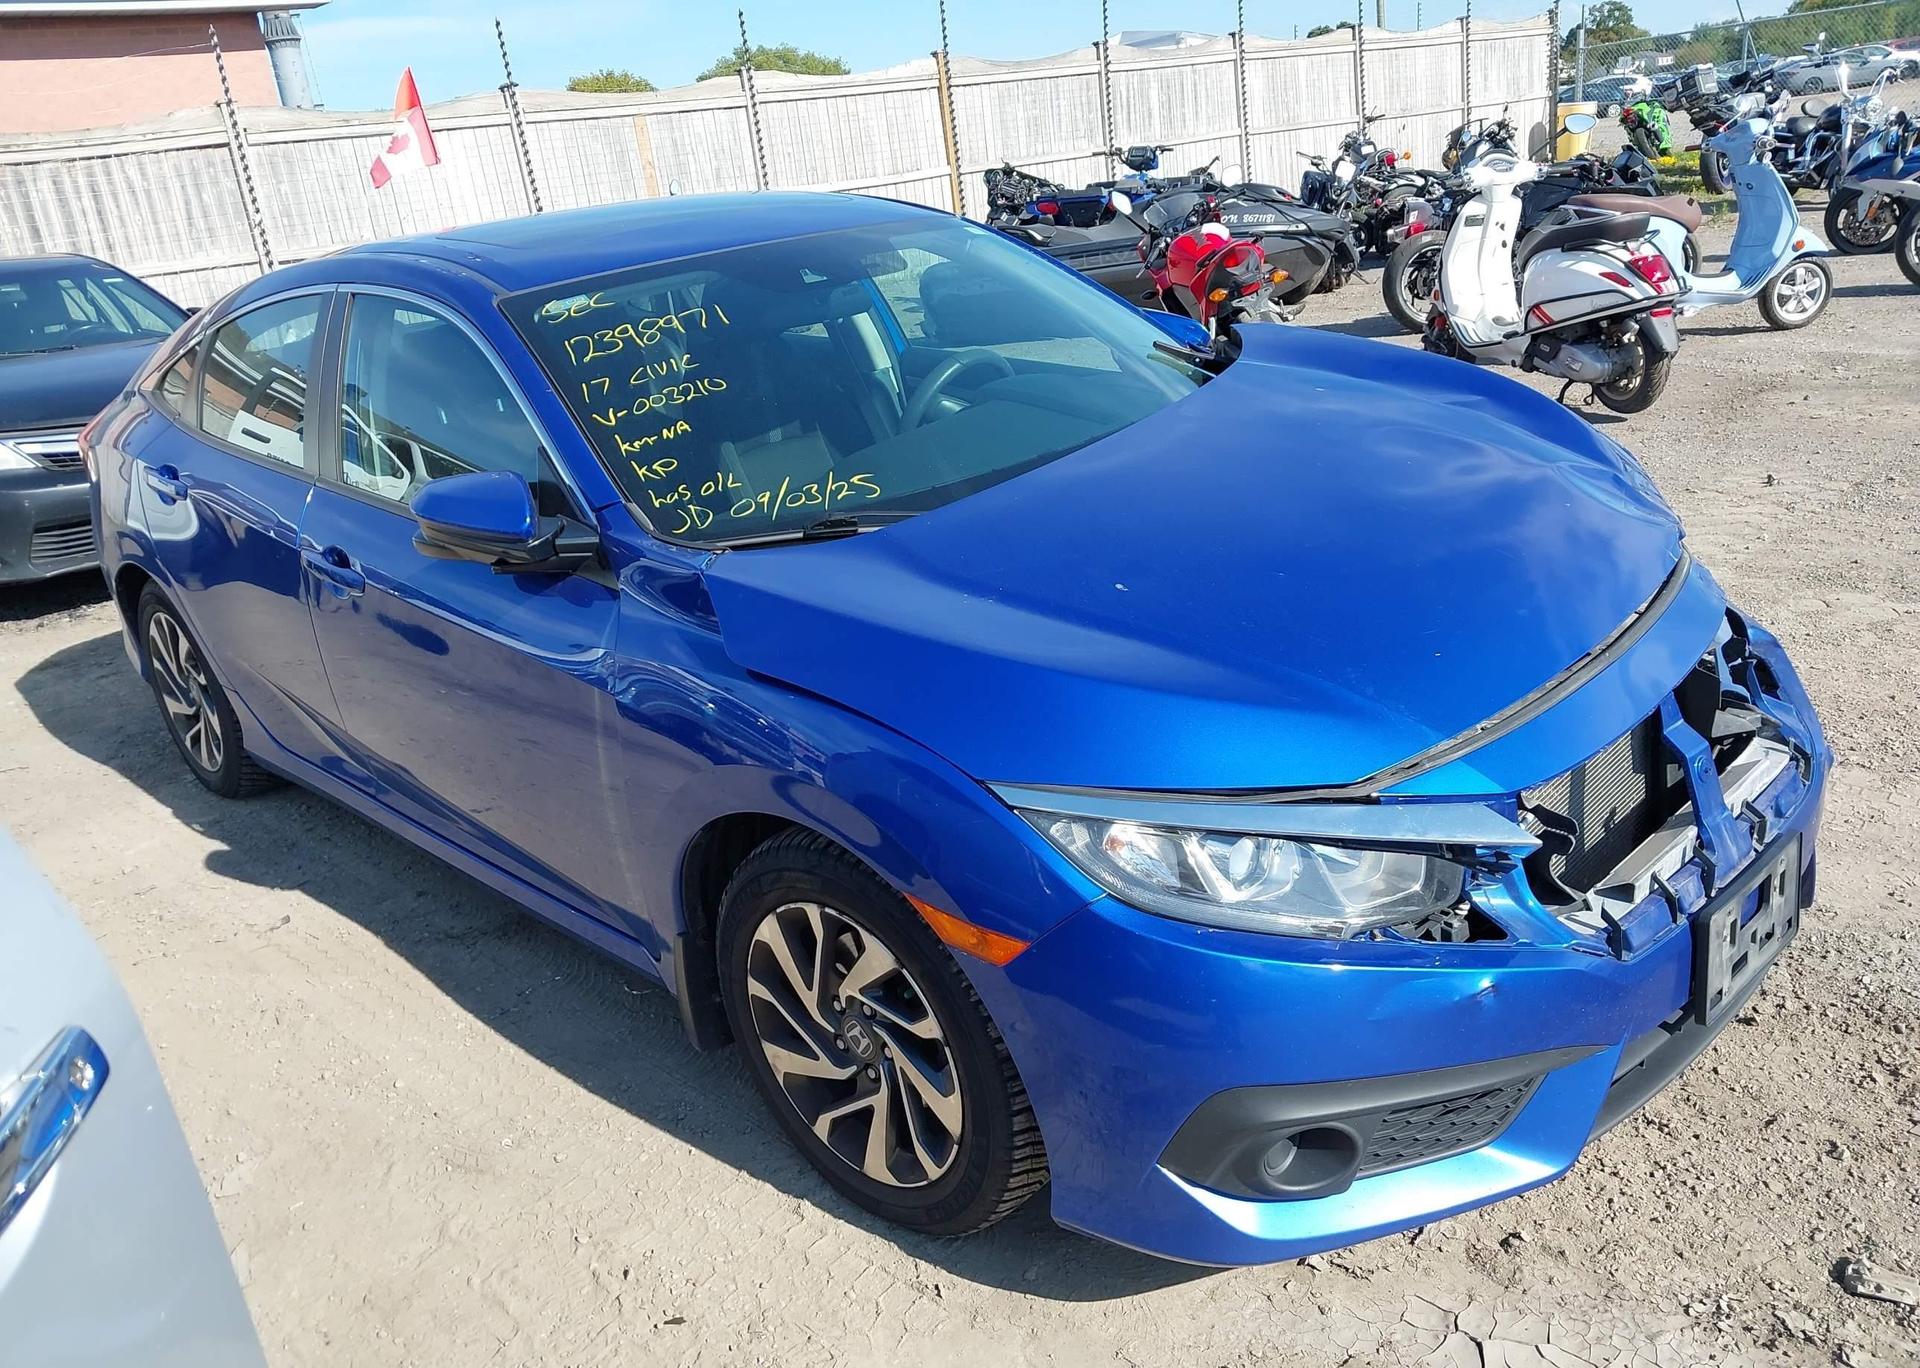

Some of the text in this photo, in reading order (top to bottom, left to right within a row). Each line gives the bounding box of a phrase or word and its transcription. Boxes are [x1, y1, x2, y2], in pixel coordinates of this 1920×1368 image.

[563, 303, 731, 366] 12398971
[581, 353, 700, 404] 17 CIVIC
[647, 484, 692, 508] has
[671, 470, 881, 534] JD 09/03/25
